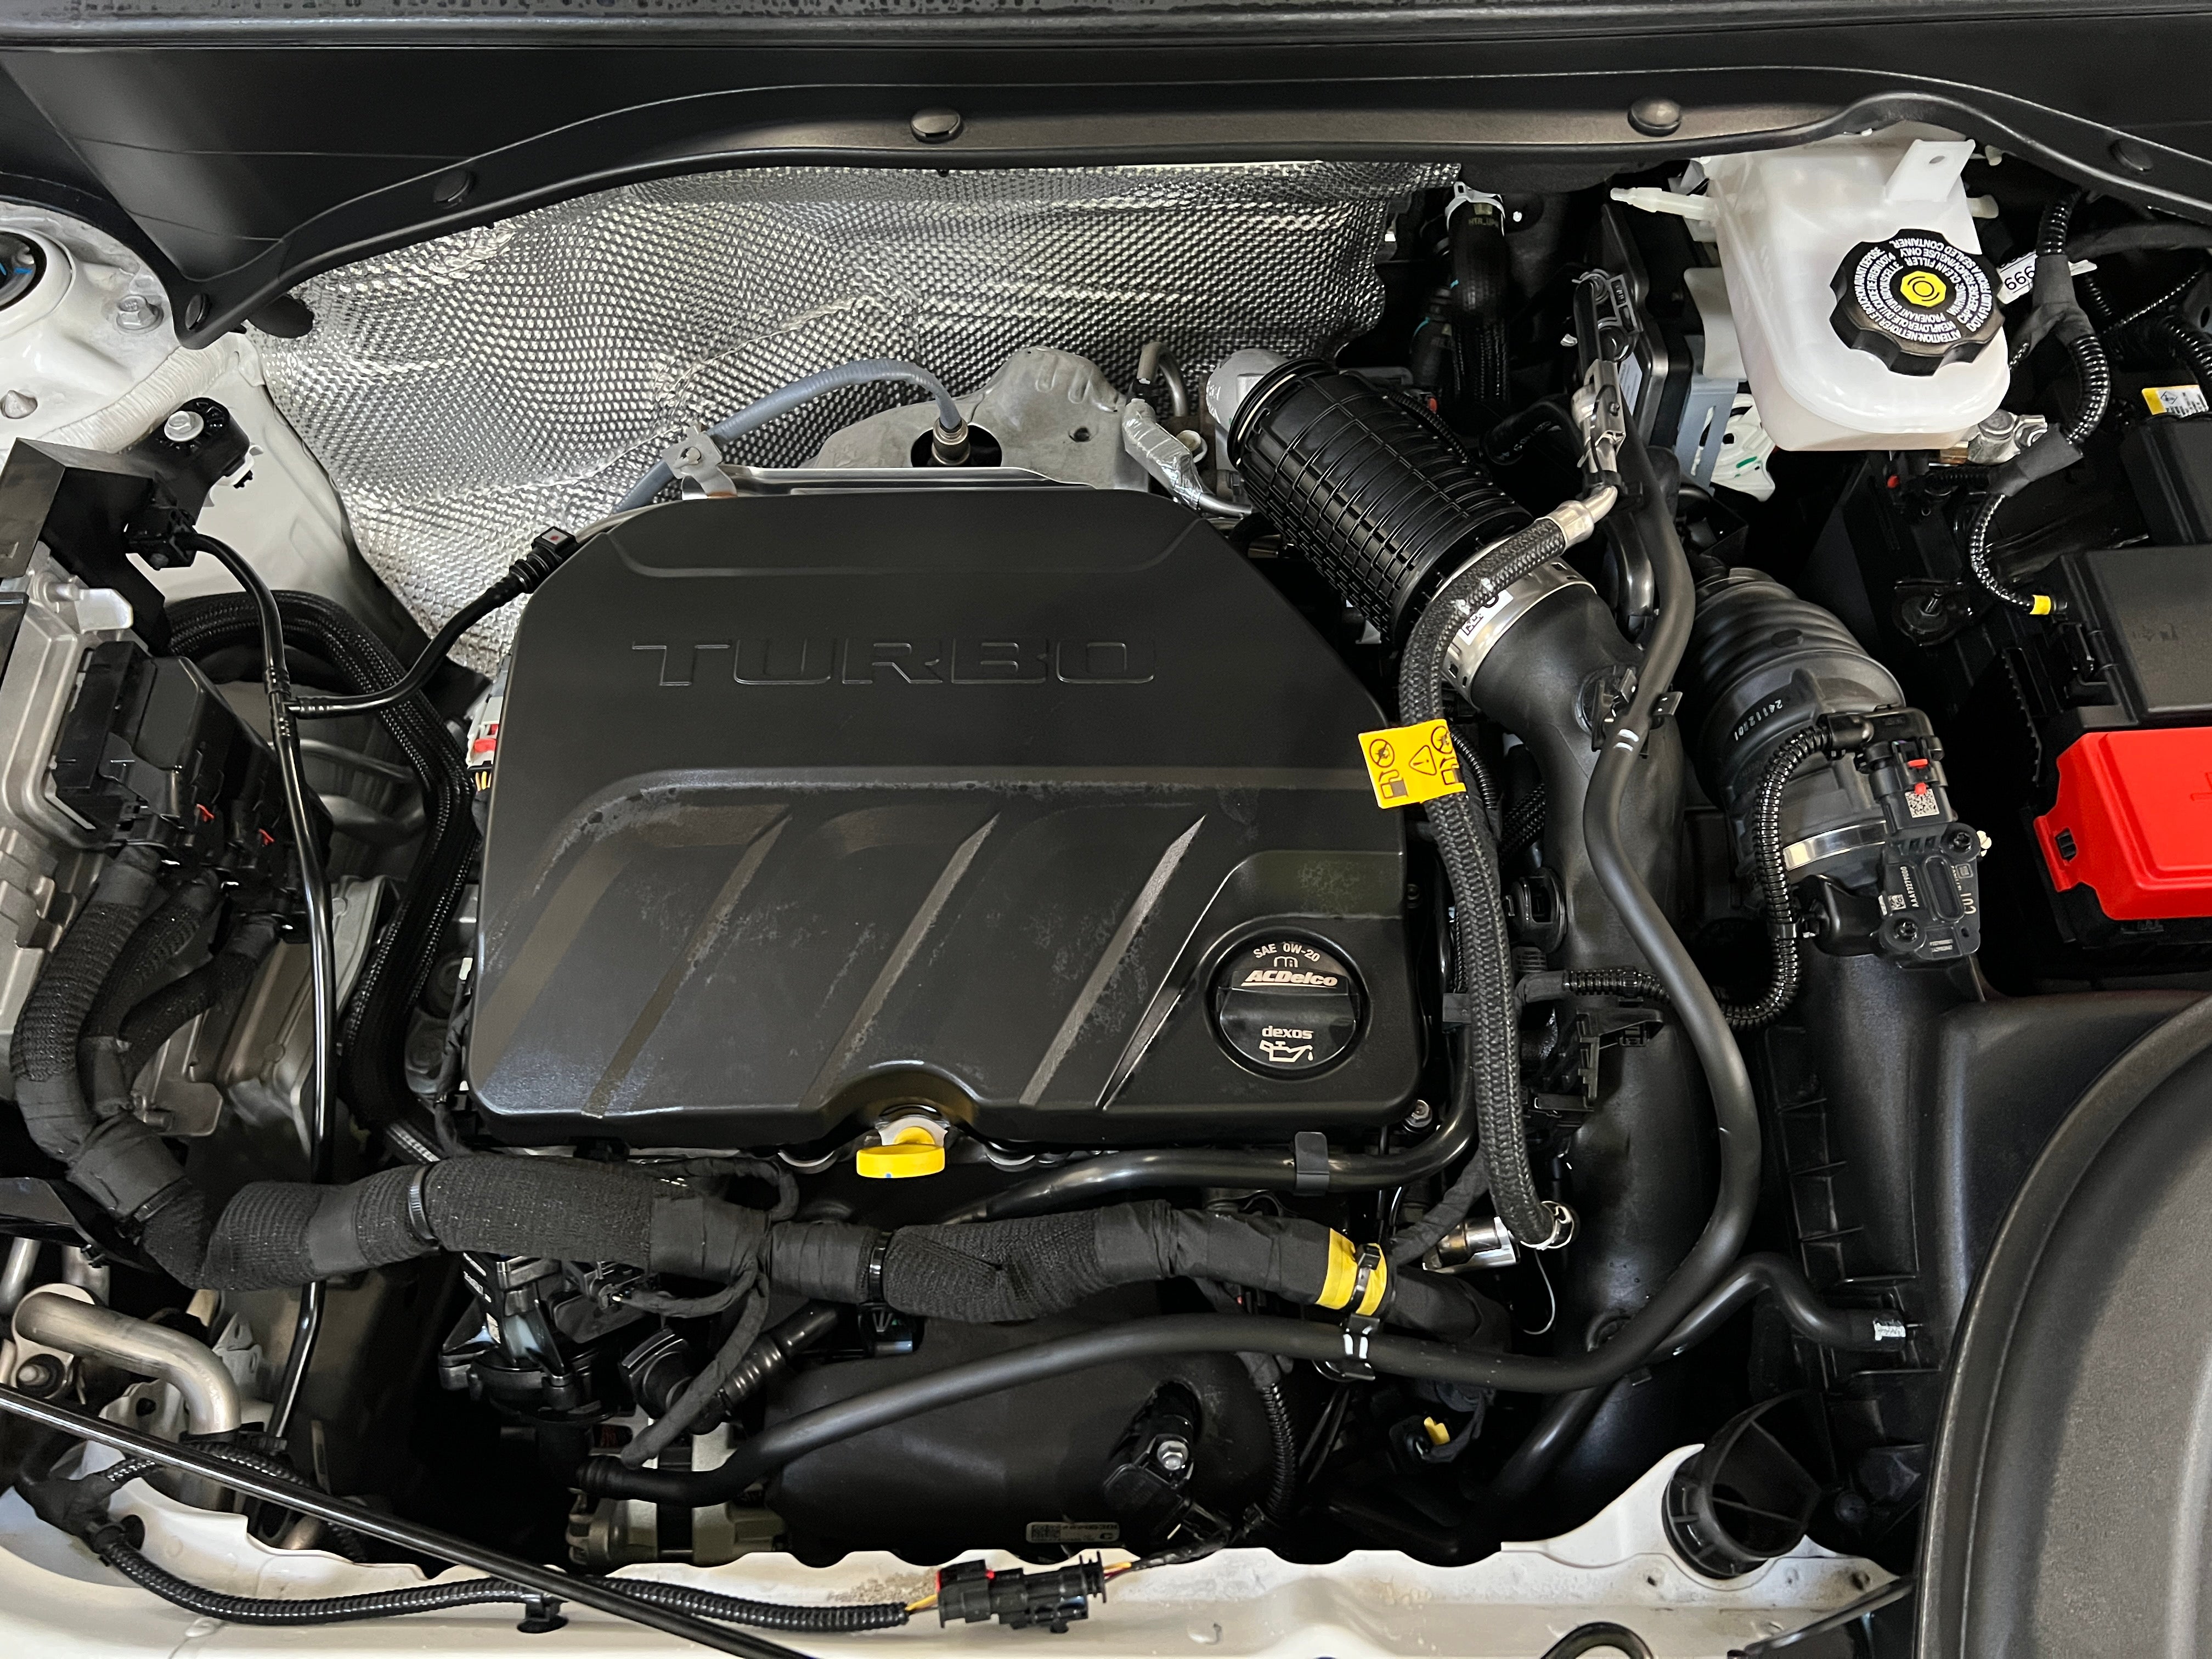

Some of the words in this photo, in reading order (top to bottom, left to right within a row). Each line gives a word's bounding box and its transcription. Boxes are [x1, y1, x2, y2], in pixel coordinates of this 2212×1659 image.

[1889, 238, 1944, 251] CONTAINER.
[1900, 247, 1922, 257] ONLY
[1876, 254, 1891, 268] DOT
[1904, 257, 1936, 268] FILLER
[1923, 249, 1940, 260] USE
[1944, 246, 1976, 269] SEALED
[1854, 266, 1867, 286] AVANT
[1867, 263, 1882, 281] FREIN
[1935, 262, 1961, 283] CLEAN
[1939, 253, 1976, 285] REMOVING
[1867, 280, 1877, 290] DE
[1974, 272, 1991, 294] FROM
[1854, 286, 1876, 315] BOUCHON
[1867, 290, 1888, 313] LIQUIDE
[1966, 284, 1979, 312] BEFORE
[1978, 294, 1992, 315] FLUID
[1869, 312, 1882, 322] LE
[1881, 309, 1895, 320] DU
[1891, 314, 1909, 328] QUE
[1899, 308, 1946, 323] PROVENANT
[1957, 309, 1973, 324] CAP
[1879, 318, 1918, 342] NETTOYER
[1966, 315, 1984, 332] DOT
[631, 636, 1155, 686] TURBO
[1253, 943, 1277, 958] SAE
[1245, 969, 1338, 986] ACDelco
[1262, 1025, 1314, 1040] dexos
